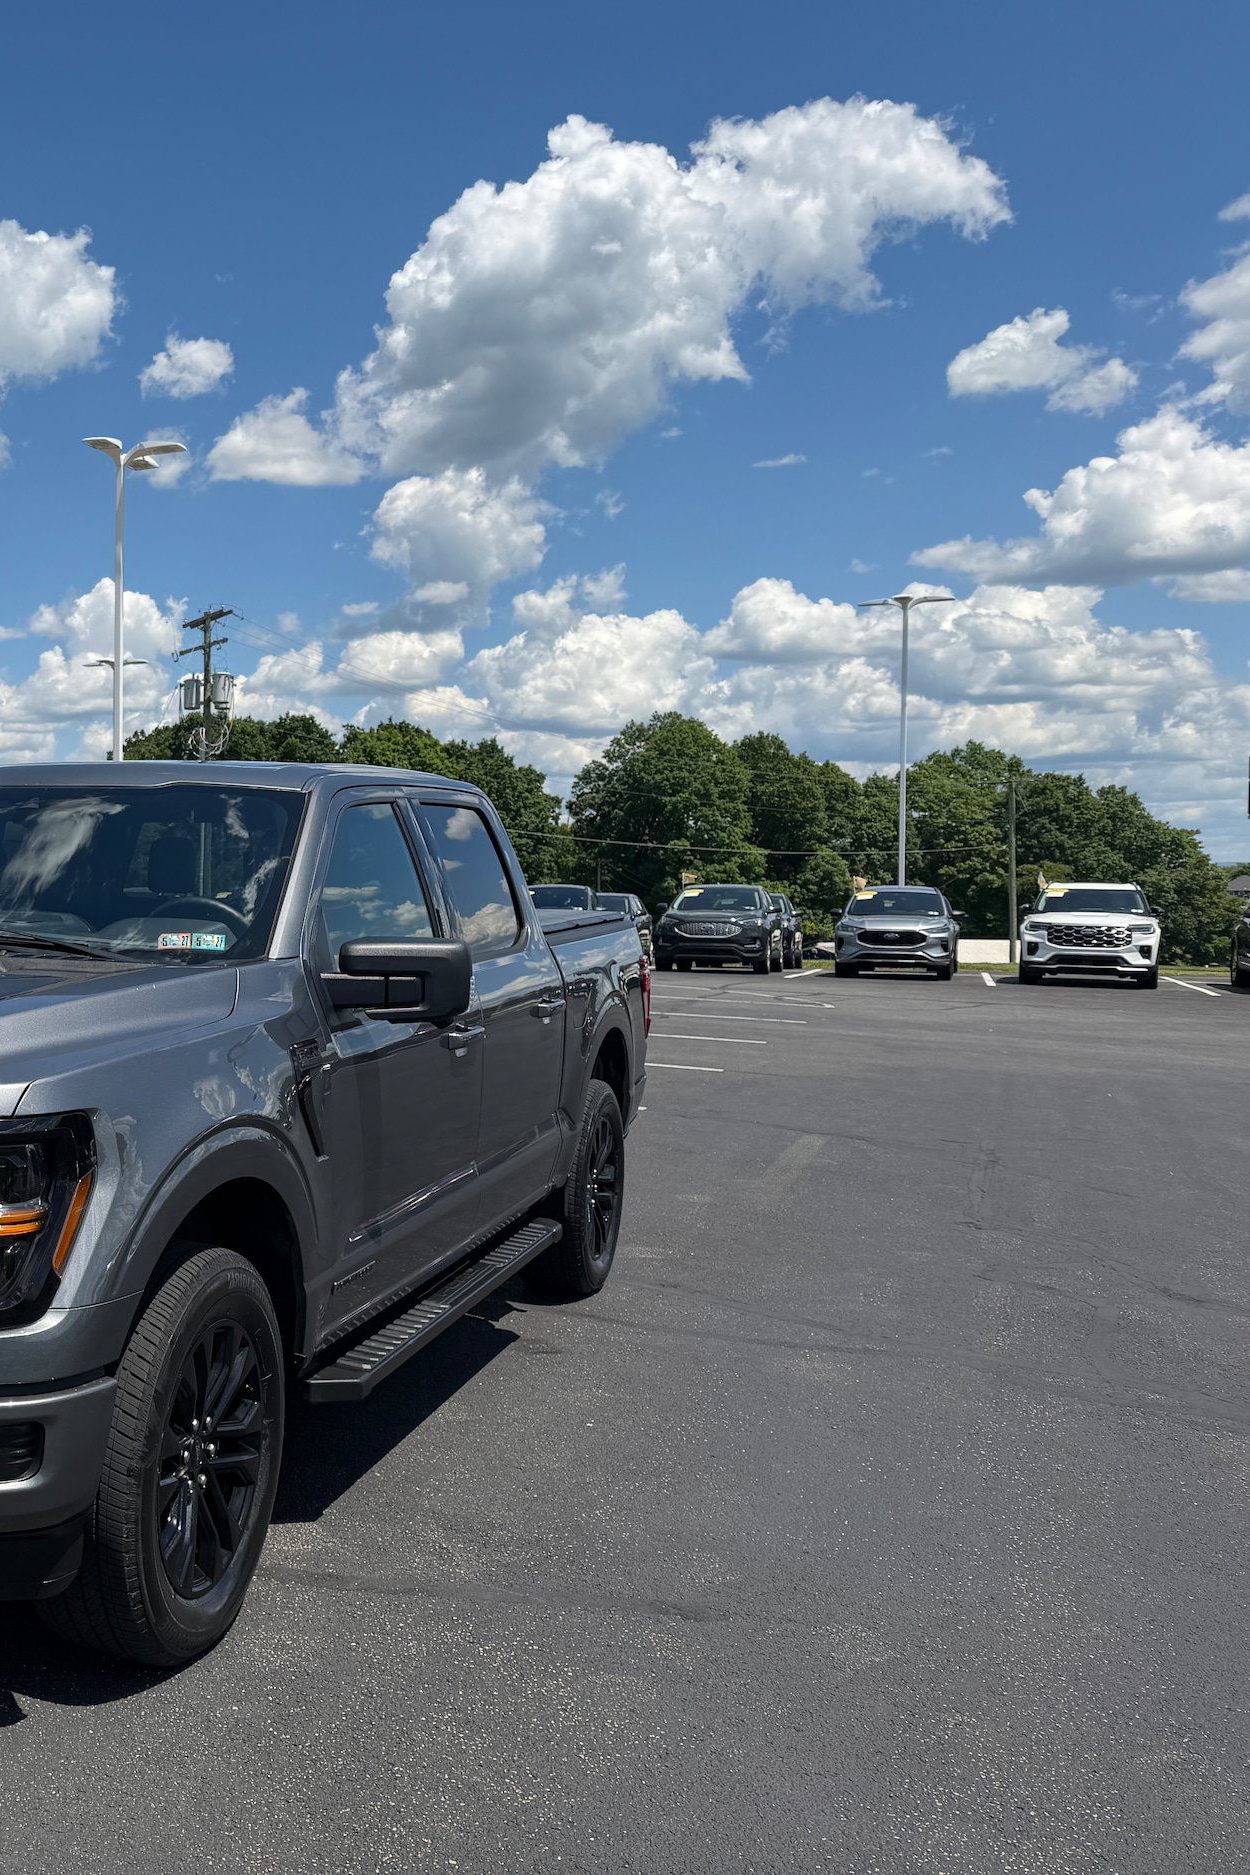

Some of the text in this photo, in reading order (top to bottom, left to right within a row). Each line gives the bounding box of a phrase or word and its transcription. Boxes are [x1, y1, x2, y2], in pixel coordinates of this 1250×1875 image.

[162, 935, 189, 947] 5 27
[196, 937, 201, 947] 5
